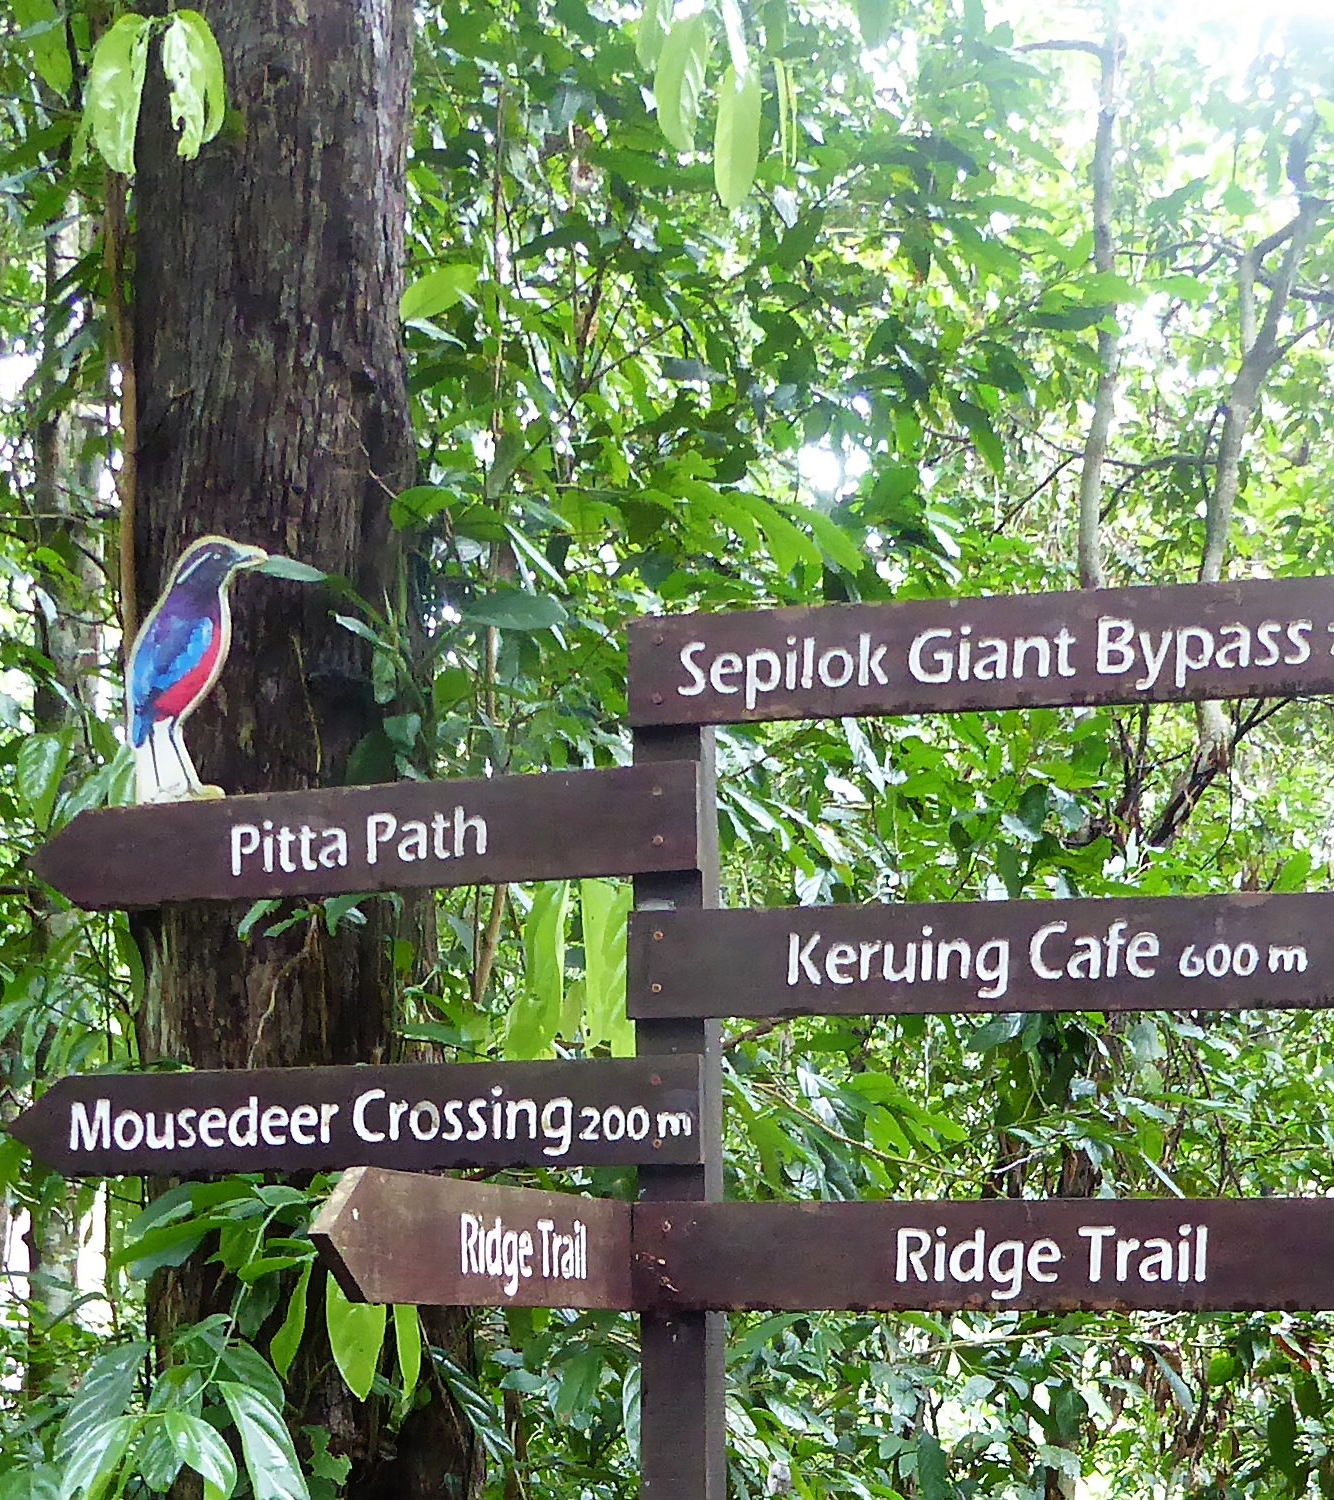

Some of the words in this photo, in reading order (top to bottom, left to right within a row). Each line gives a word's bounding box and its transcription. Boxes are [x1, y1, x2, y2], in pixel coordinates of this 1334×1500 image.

[677, 631, 889, 711] Sepilok
[908, 623, 1077, 684] Giant
[1096, 613, 1313, 691] Bypass
[230, 819, 348, 876] Pitta
[366, 805, 488, 865] Path
[787, 924, 1010, 999] Keruing
[1028, 920, 1160, 980] Cafe
[1178, 941, 1260, 978] 600
[1267, 944, 1309, 973] m
[69, 1095, 340, 1152] Mousedeer
[352, 1085, 574, 1157] Crossing
[578, 1104, 651, 1141] 200
[656, 1111, 692, 1138] m
[460, 1211, 534, 1297] Ridge
[536, 1218, 587, 1280] Trail
[895, 1225, 1062, 1300] Ridge
[1077, 1223, 1208, 1283] Trail
